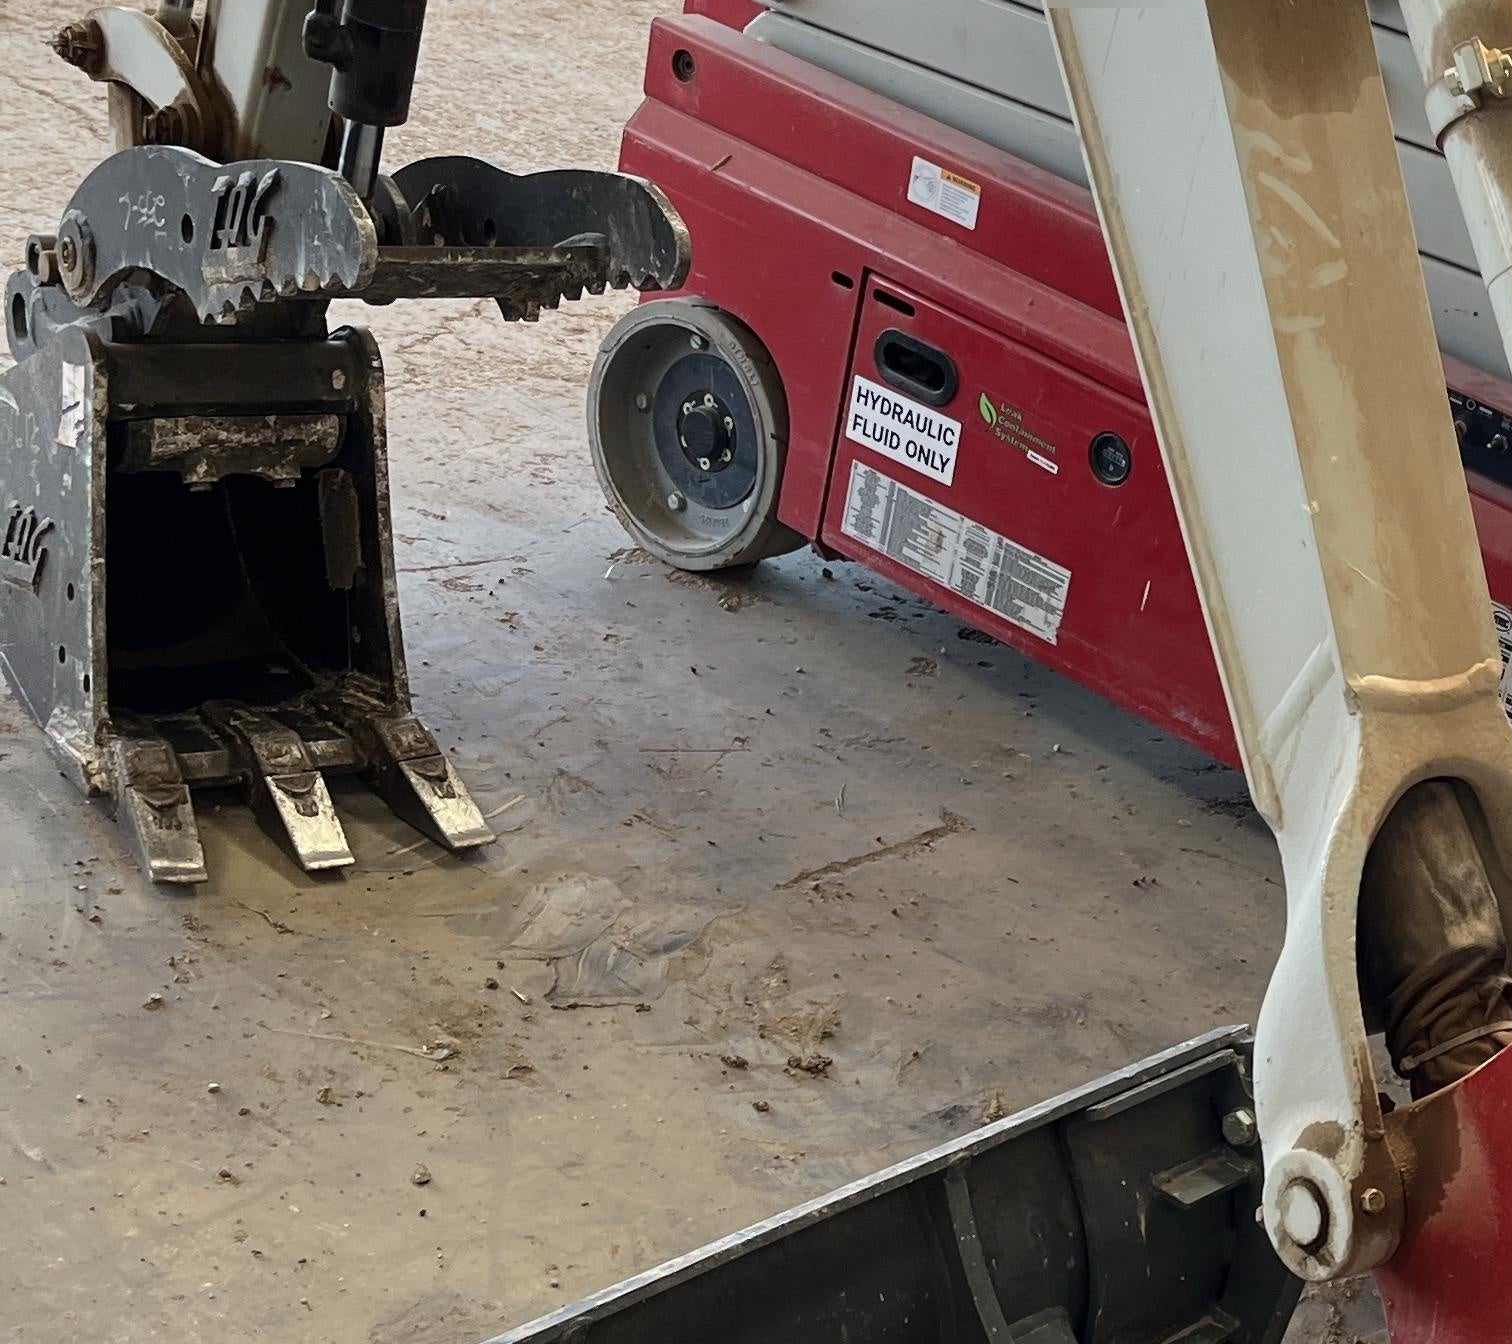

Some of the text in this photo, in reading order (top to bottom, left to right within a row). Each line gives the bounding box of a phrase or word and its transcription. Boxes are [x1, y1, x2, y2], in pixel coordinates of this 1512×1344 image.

[852, 413, 951, 474] FLUID ONLY
[856, 385, 955, 447] HYDRAULIC
